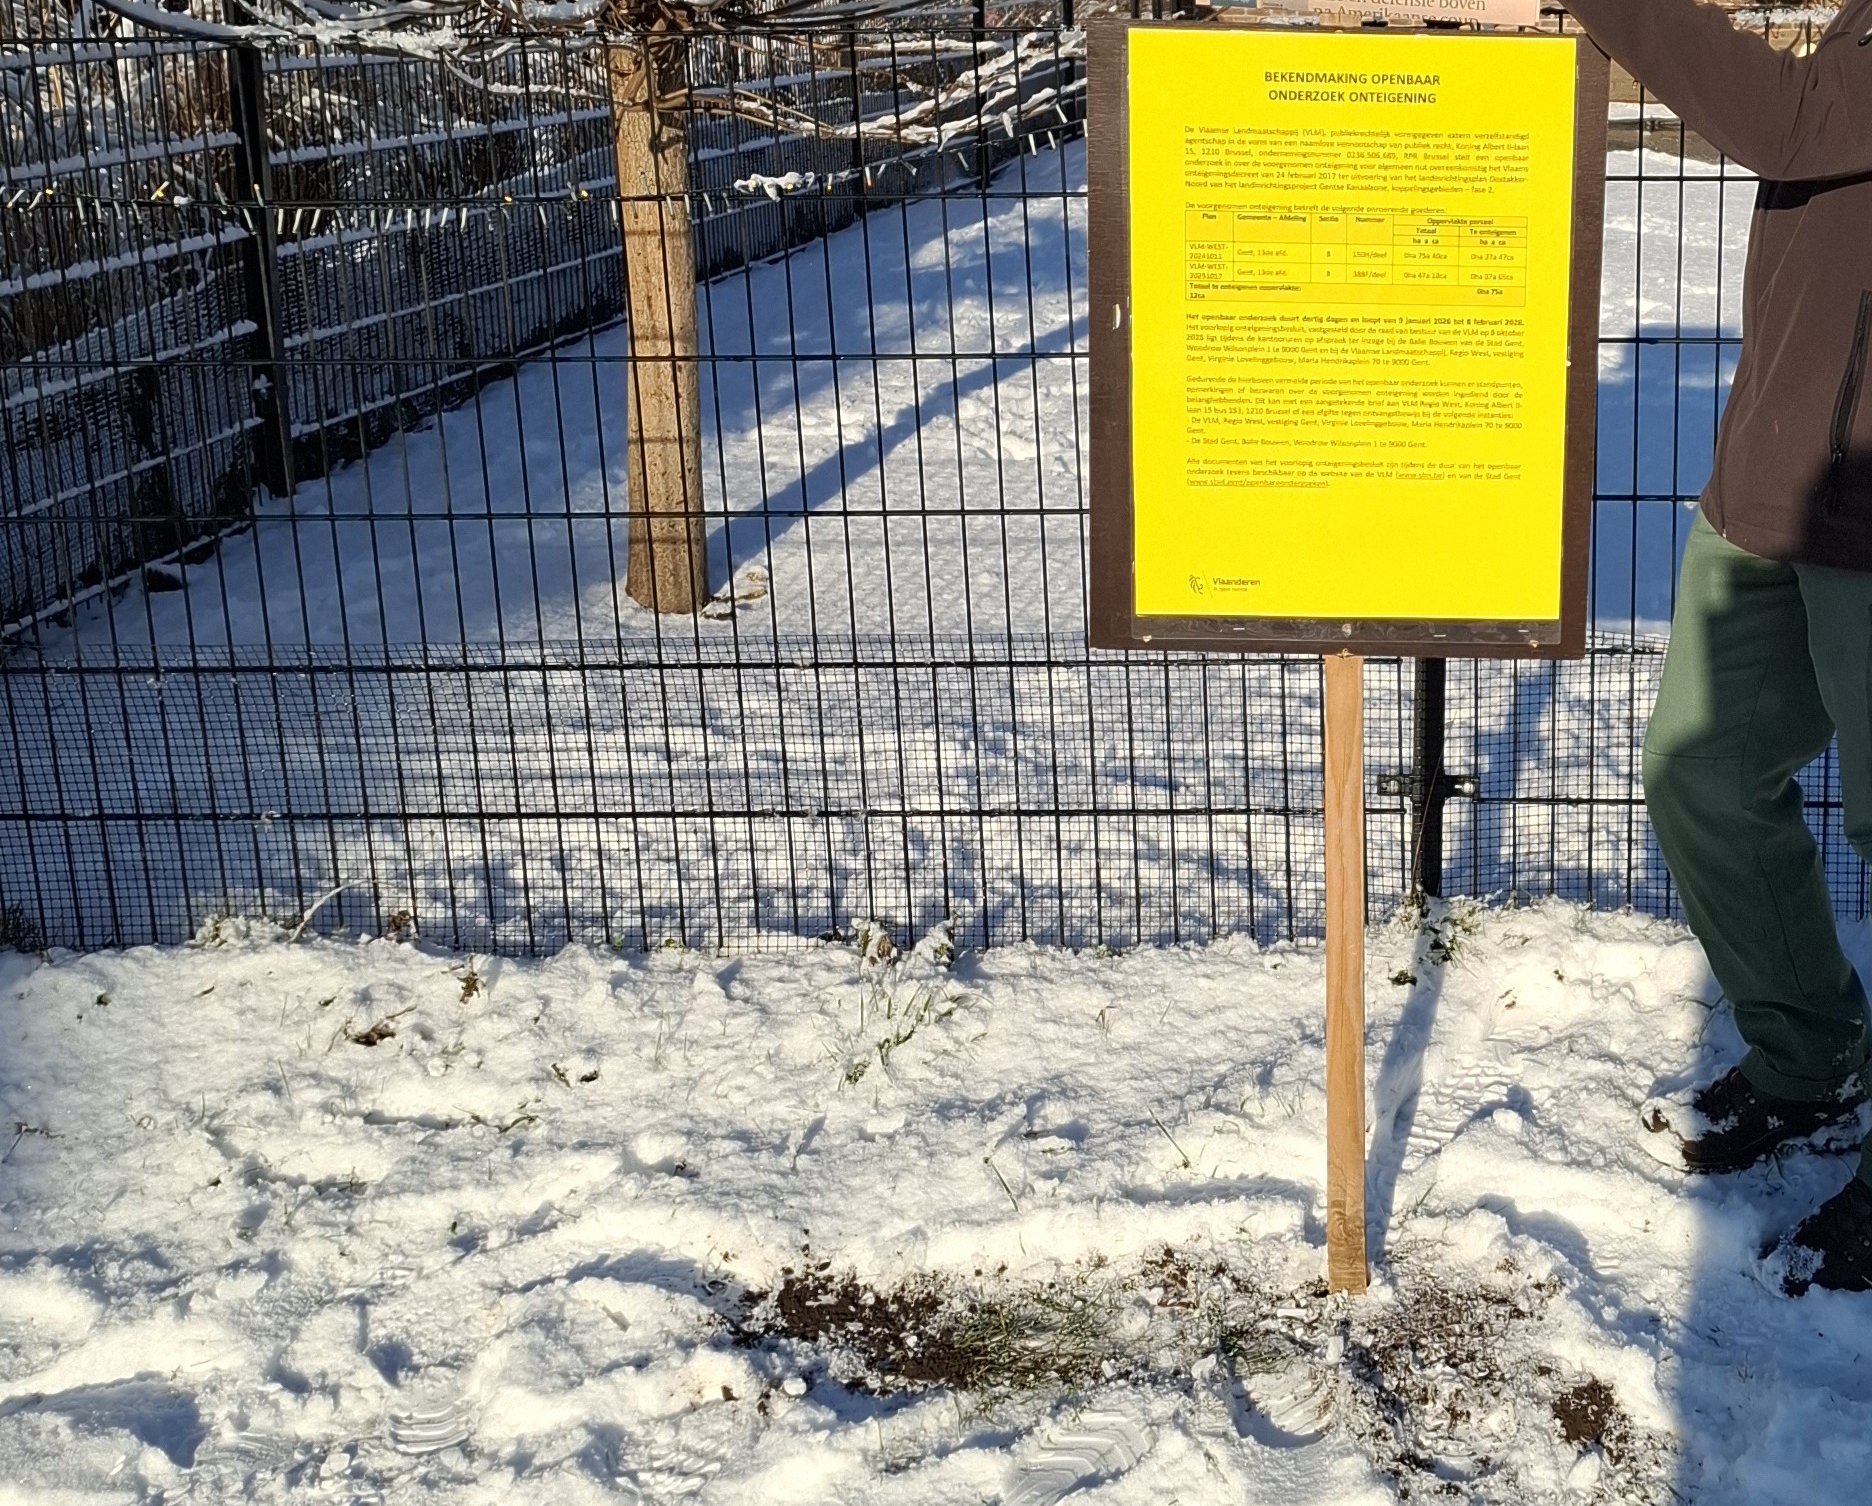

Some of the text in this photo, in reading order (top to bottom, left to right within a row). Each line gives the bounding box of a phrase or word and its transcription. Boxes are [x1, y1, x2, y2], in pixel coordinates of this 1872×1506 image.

[1265, 71, 1440, 85] BEKENDMAKING OPENBAAR
[1268, 90, 1436, 104] ONDERZOEK ONTEIGENING
[1212, 578, 1260, 586] Vlaanderen
